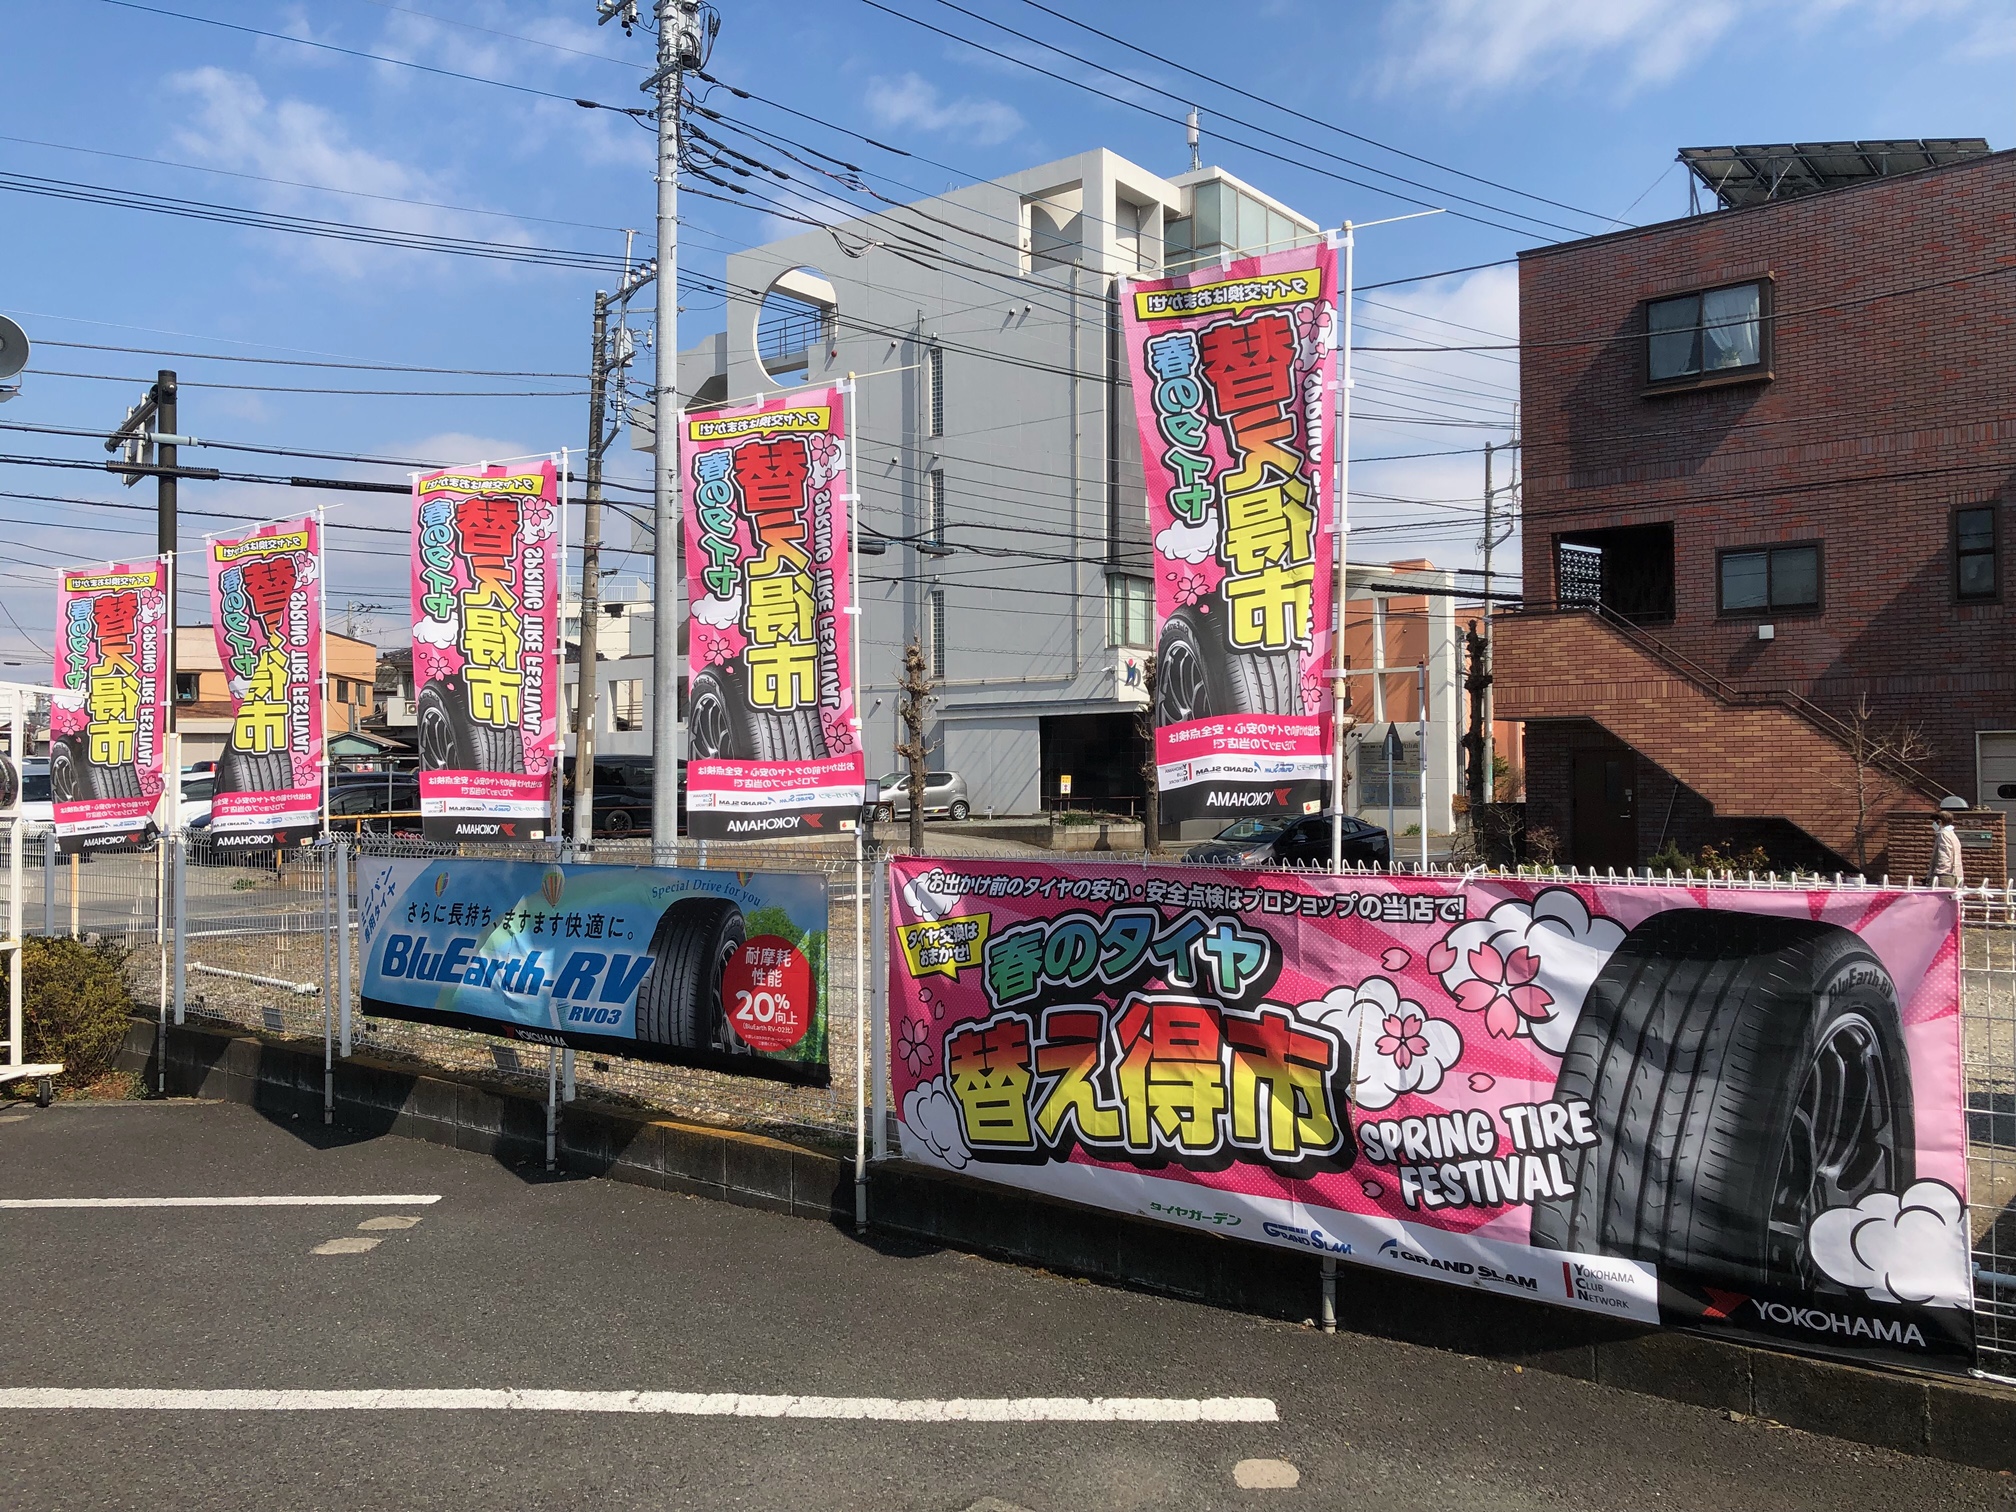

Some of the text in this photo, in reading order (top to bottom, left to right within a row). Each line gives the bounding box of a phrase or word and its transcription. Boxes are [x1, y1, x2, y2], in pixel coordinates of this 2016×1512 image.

[361, 865, 393, 928] ミニバン
[651, 878, 762, 907] Special Drive for you
[928, 872, 1466, 922] お出かけ前のタイヤの安心・安全点検はプロショップの当店で!
[407, 901, 634, 941] さらに長持ち、ますます快適に。
[907, 921, 978, 948] タイヤ交換は
[381, 934, 655, 1005] BluEarth-RV
[745, 946, 792, 968] 耐摩耗
[919, 944, 970, 968] おまかせ!
[990, 915, 1263, 1001] 春のタイヤ
[751, 967, 783, 988] 性能
[568, 1005, 623, 1025] RV03
[735, 989, 790, 1023] 20%
[775, 1011, 798, 1025] 向上
[515, 1029, 569, 1047] YOKOHAMA
[950, 999, 1337, 1155] 替え得市
[1359, 1100, 1597, 1162] SPRING TIRE
[1400, 1153, 1575, 1208] FESTIVAL
[1150, 1202, 1242, 1226] タイヤガーデン
[1262, 1221, 1352, 1254] GRAND SLAM
[1401, 1251, 1475, 1275] GRAND
[1477, 1266, 1538, 1289] SLAM
[1573, 1263, 1635, 1283] YOKOHAMA
[1575, 1278, 1604, 1293] CLUB
[1577, 1289, 1630, 1309] NETWORK
[1751, 1298, 1926, 1347] YOKOHAMA
